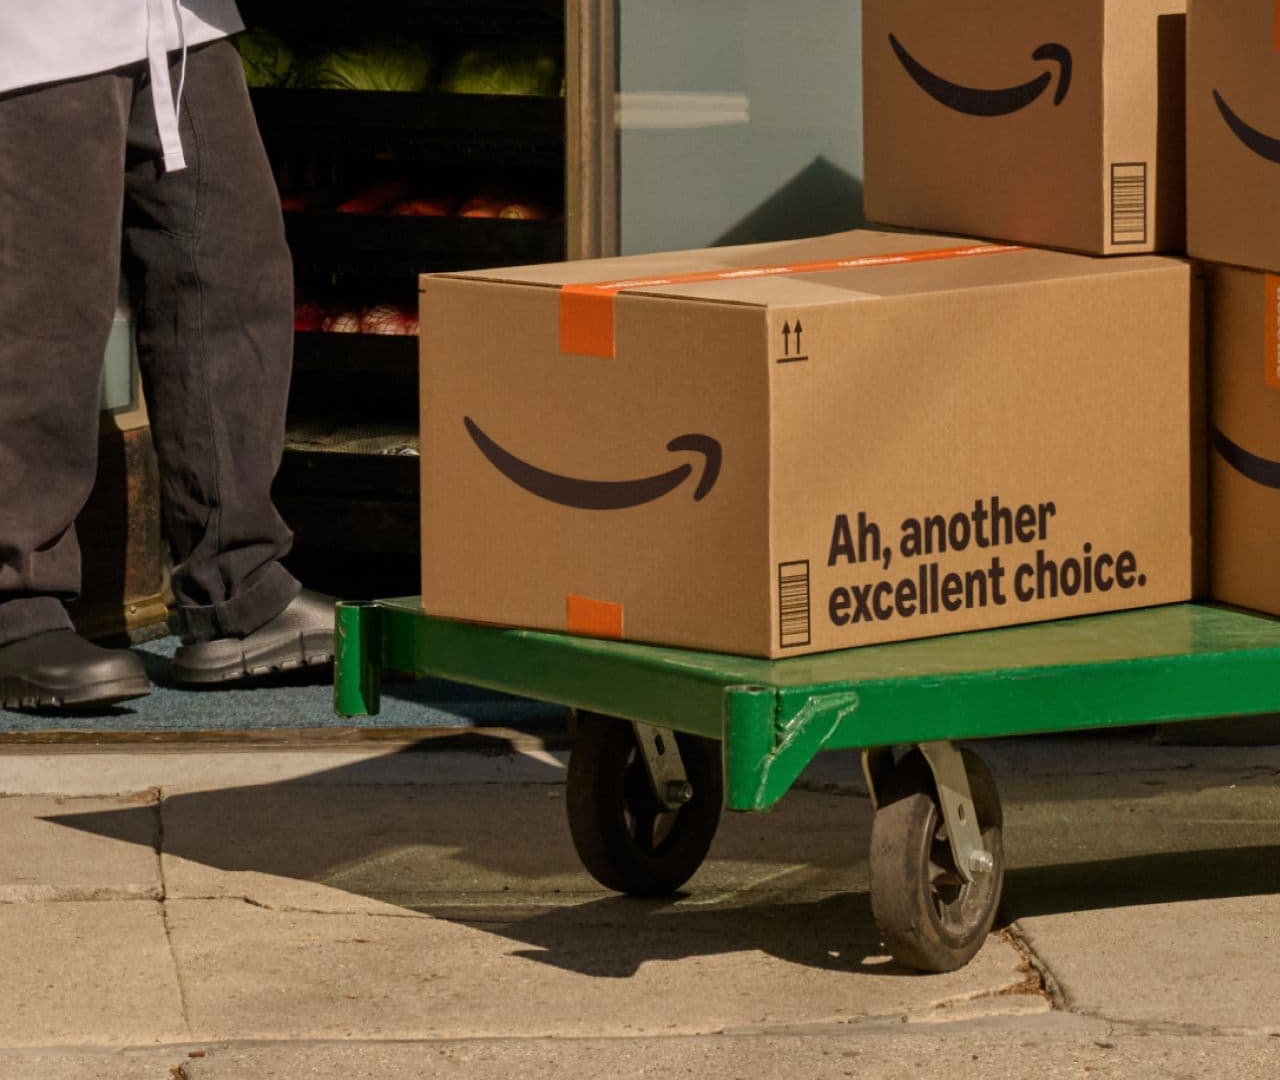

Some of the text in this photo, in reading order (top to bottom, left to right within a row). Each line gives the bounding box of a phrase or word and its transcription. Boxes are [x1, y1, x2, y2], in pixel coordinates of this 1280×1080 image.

[827, 495, 1057, 571] Ah, another
[828, 541, 1147, 627] excellent choice.
